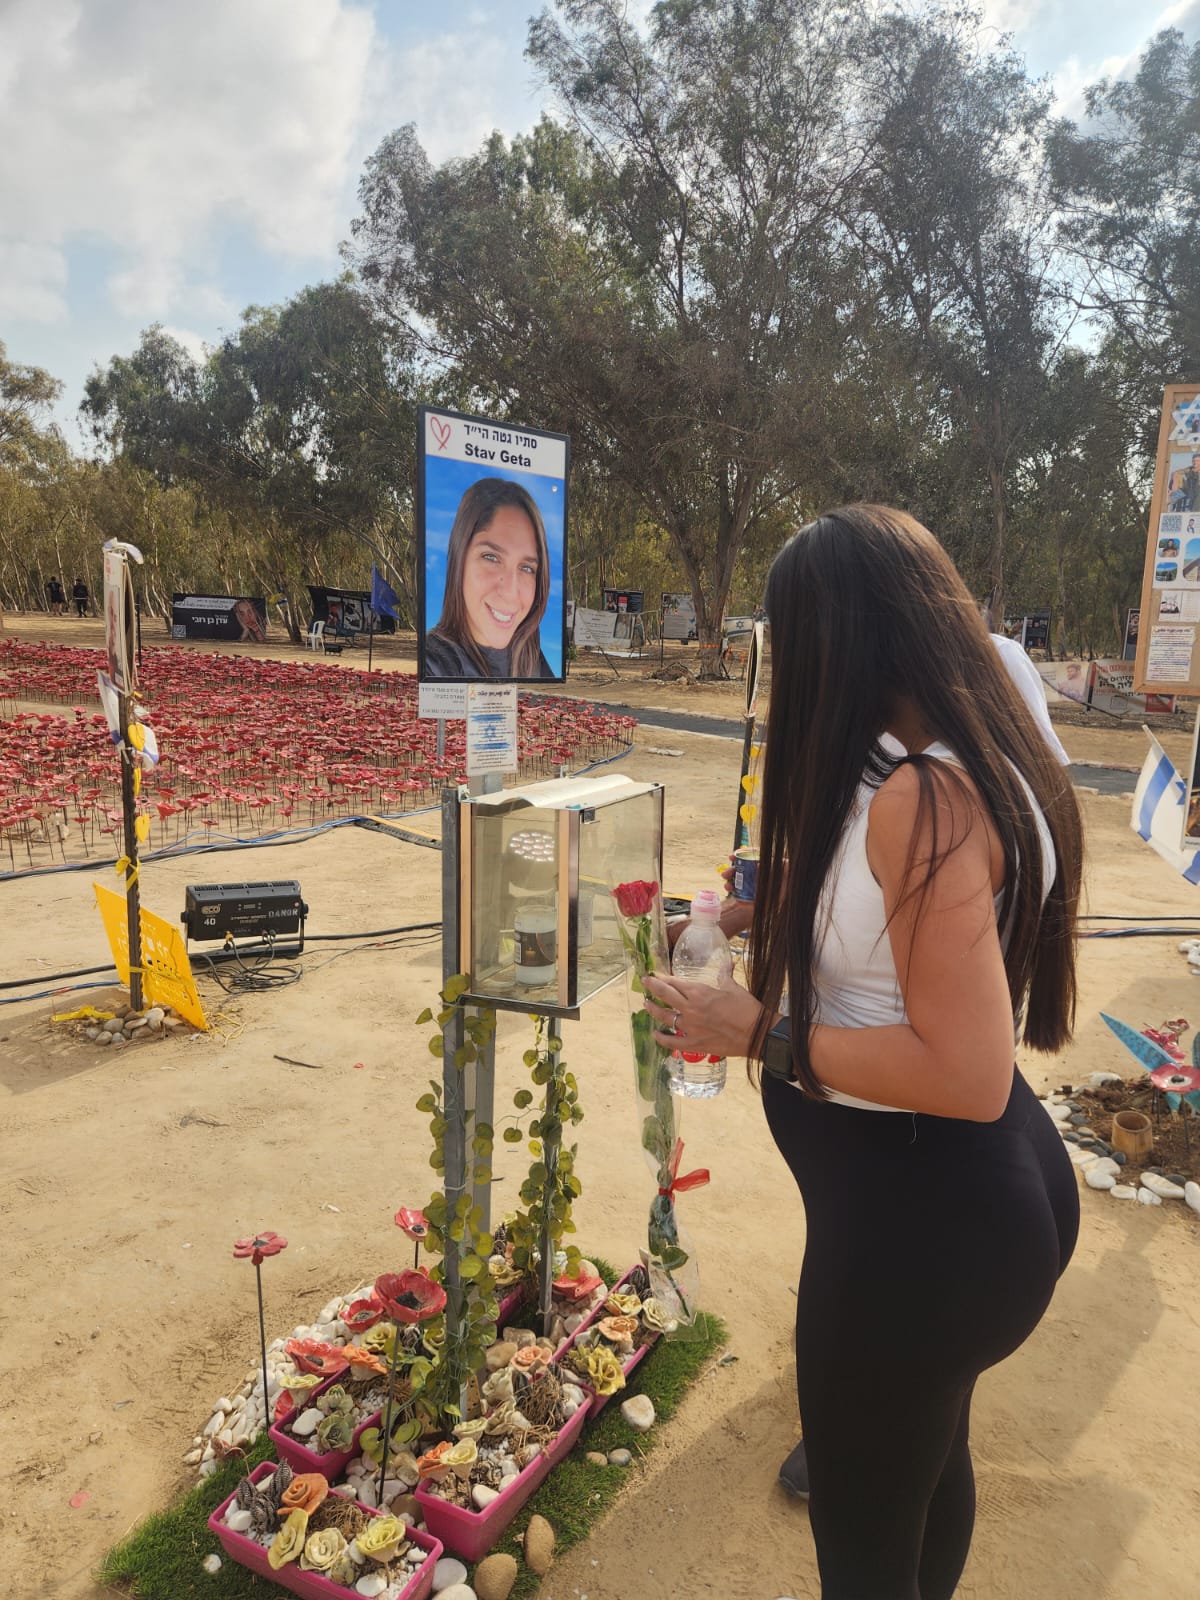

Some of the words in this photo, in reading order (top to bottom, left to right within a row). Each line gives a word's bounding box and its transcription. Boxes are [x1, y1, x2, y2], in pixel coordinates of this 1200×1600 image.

[492, 430, 512, 444] גטה
[515, 435, 538, 449] סתיו
[464, 442, 496, 461] Stav
[500, 450, 531, 468] Geta
[203, 917, 217, 926] 40
